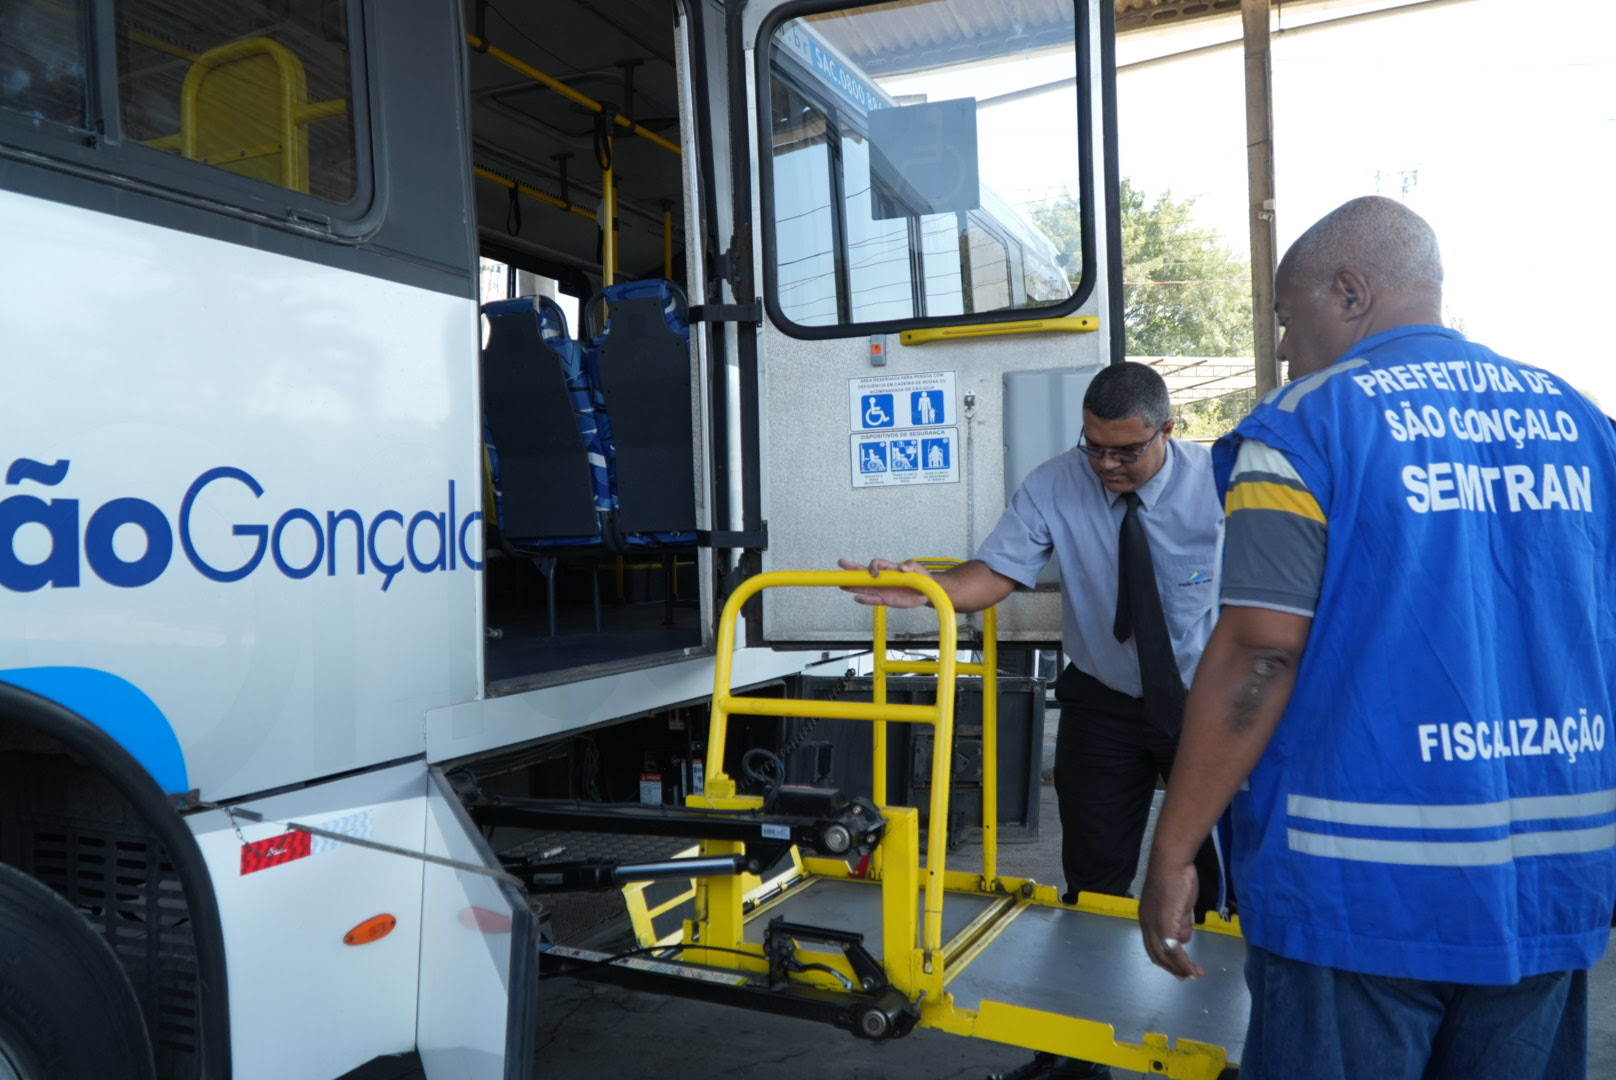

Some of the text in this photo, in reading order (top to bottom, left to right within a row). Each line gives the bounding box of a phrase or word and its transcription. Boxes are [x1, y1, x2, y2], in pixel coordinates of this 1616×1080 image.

[1352, 360, 1563, 397] PREFEITURA DE
[860, 432, 899, 440] DISPOSITIVOS
[908, 429, 945, 437] SEGURANÇA
[1384, 401, 1579, 449] SÃO GONÇALO
[1401, 462, 1593, 514] SEMTRAN
[0, 457, 173, 592] ão
[1418, 707, 1606, 764] FISCALIZAÇÃO
